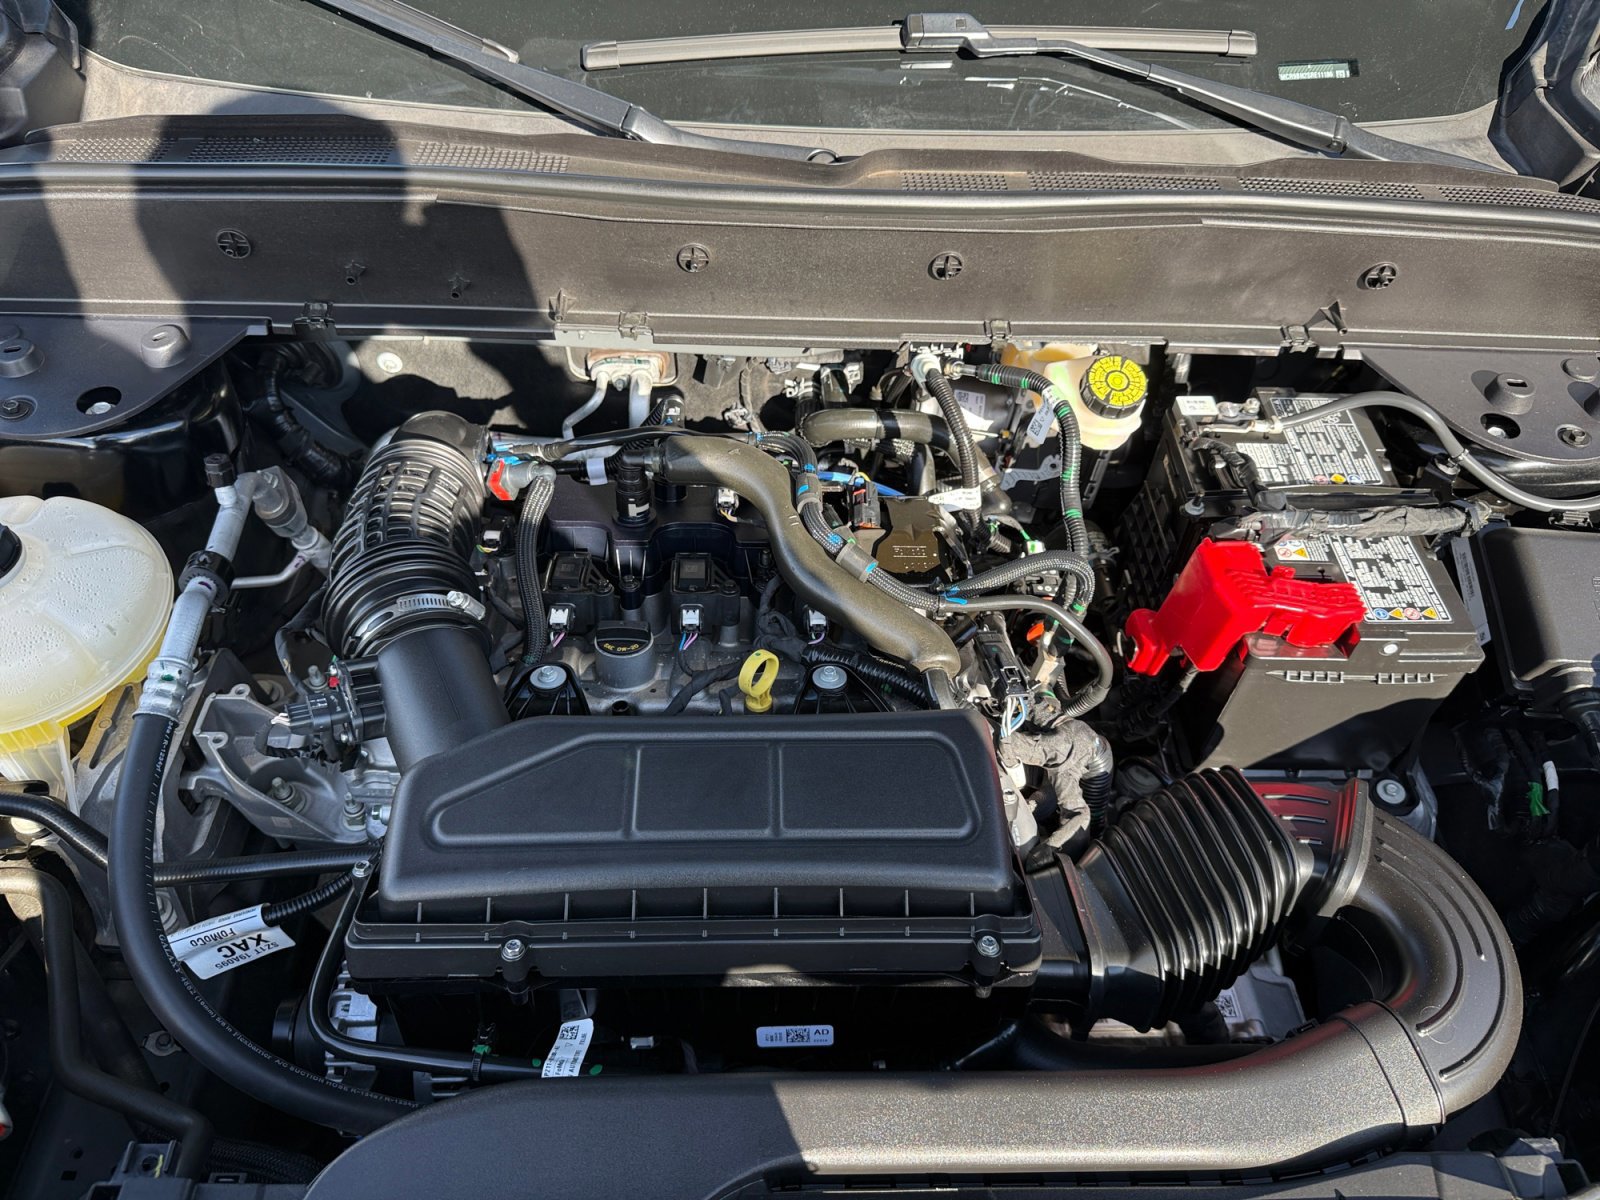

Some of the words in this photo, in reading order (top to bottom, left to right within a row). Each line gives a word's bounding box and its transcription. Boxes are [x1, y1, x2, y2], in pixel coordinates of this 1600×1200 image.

[189, 927, 237, 947] FoMoCo
[217, 933, 270, 958] XAC
[215, 953, 252, 970] 19A095
[158, 934, 182, 974] GALAXY
[274, 1058, 289, 1069] A/C
[289, 1066, 325, 1084] SUCTION
[325, 1079, 349, 1093] HOSE
[813, 1028, 830, 1036] AD
